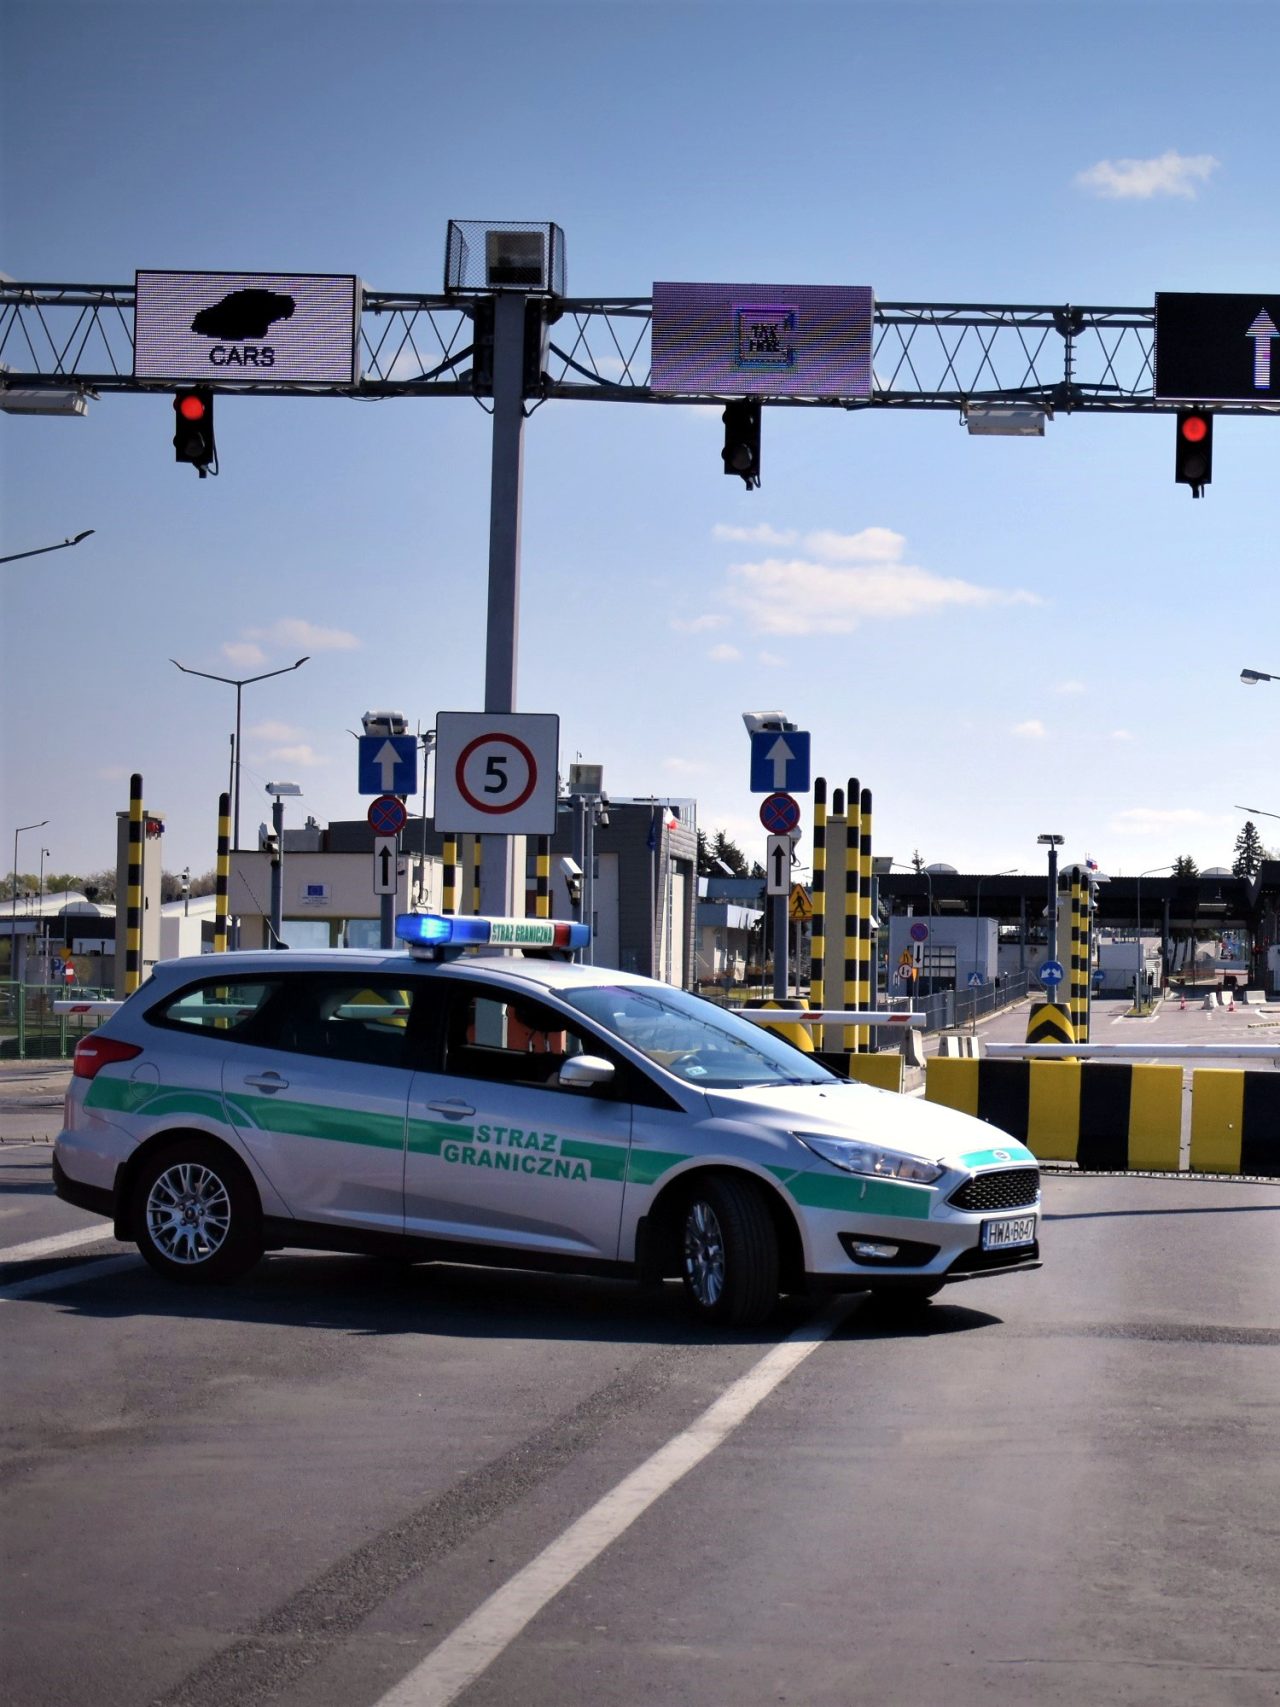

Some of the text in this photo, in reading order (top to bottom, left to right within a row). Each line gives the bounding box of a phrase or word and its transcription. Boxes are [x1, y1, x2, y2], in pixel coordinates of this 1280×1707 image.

[209, 346, 275, 367] CARS
[484, 756, 508, 793] 5
[444, 1144, 588, 1182] GRANICZNA
